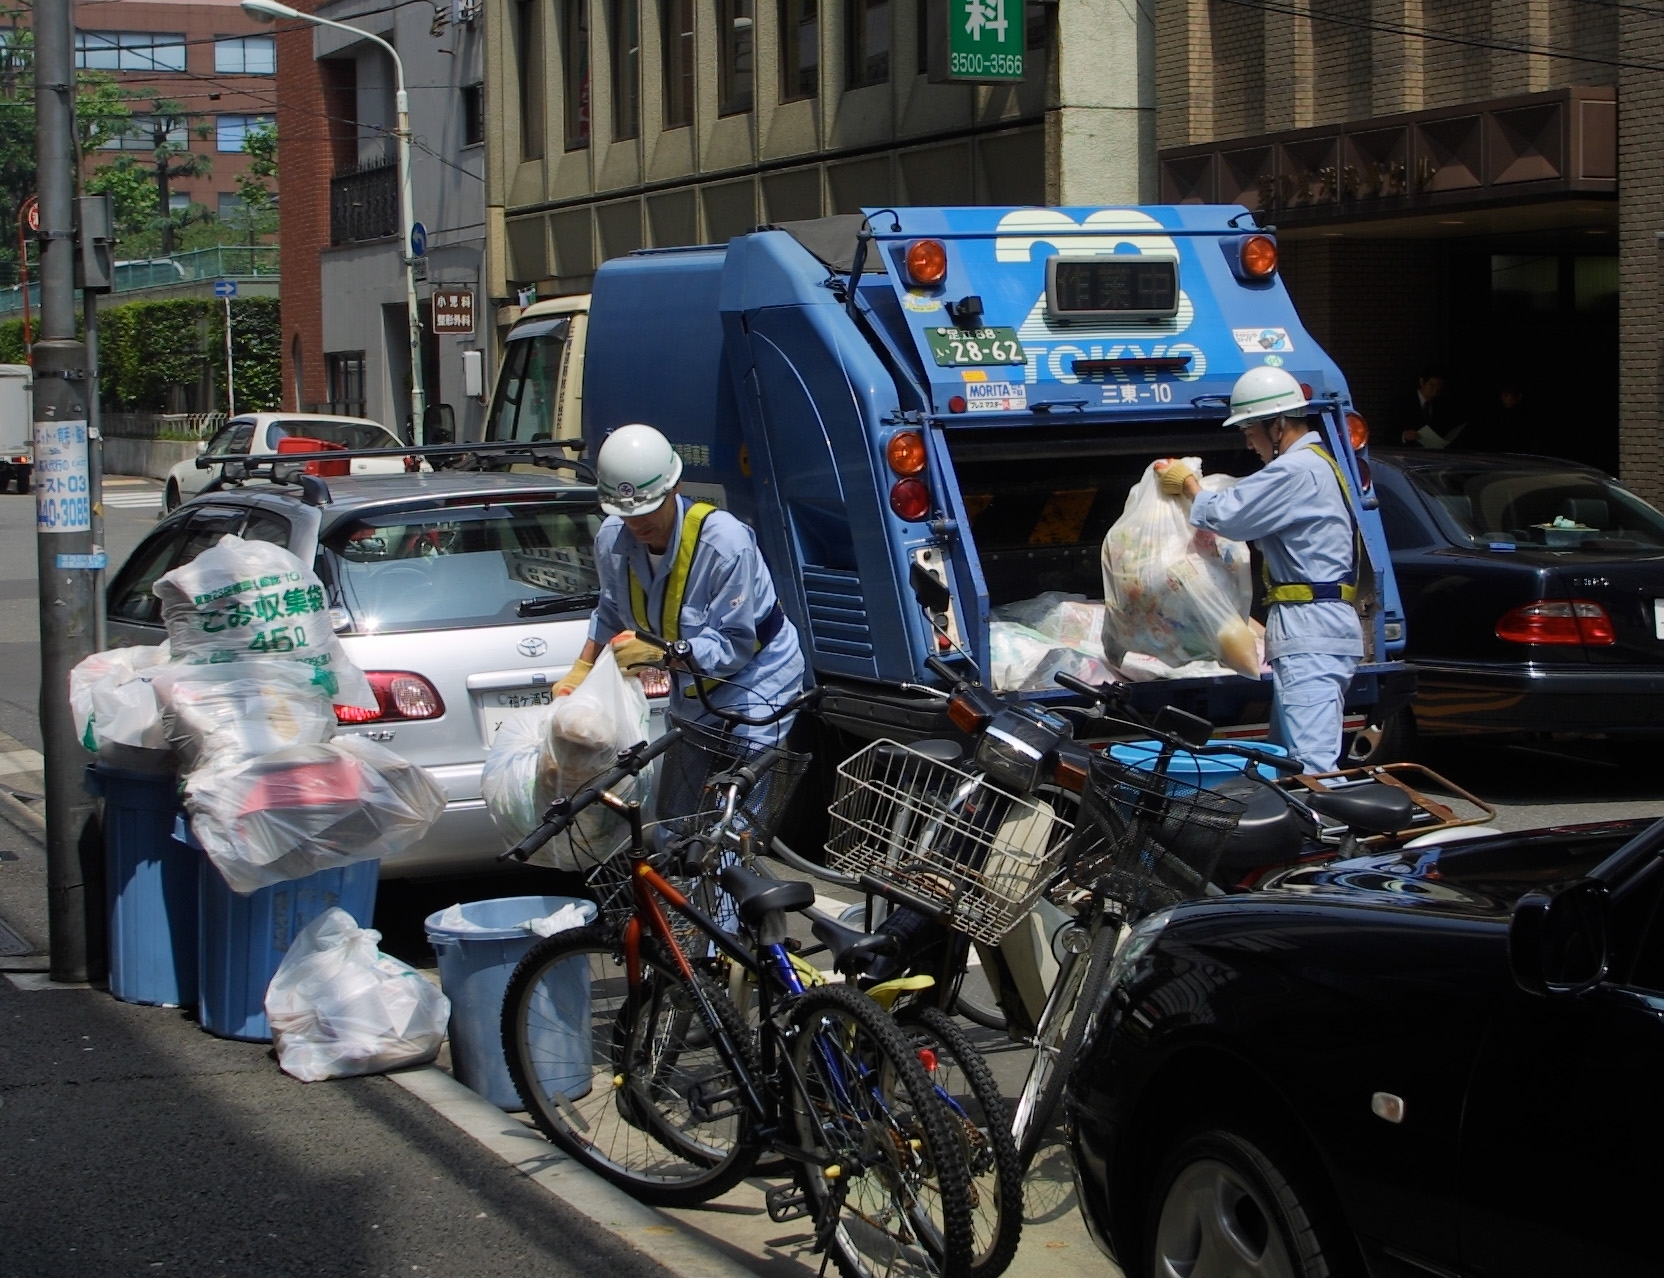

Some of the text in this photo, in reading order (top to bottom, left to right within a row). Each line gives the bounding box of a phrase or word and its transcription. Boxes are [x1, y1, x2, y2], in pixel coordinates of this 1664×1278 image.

[965, 0, 1008, 42] 科
[951, 52, 1023, 75] 3500-3566
[950, 341, 1023, 362] 28-62
[1023, 343, 1207, 385] TOKYO
[969, 383, 1011, 398] MORITA
[508, 691, 553, 708] 袖ケ浦5
